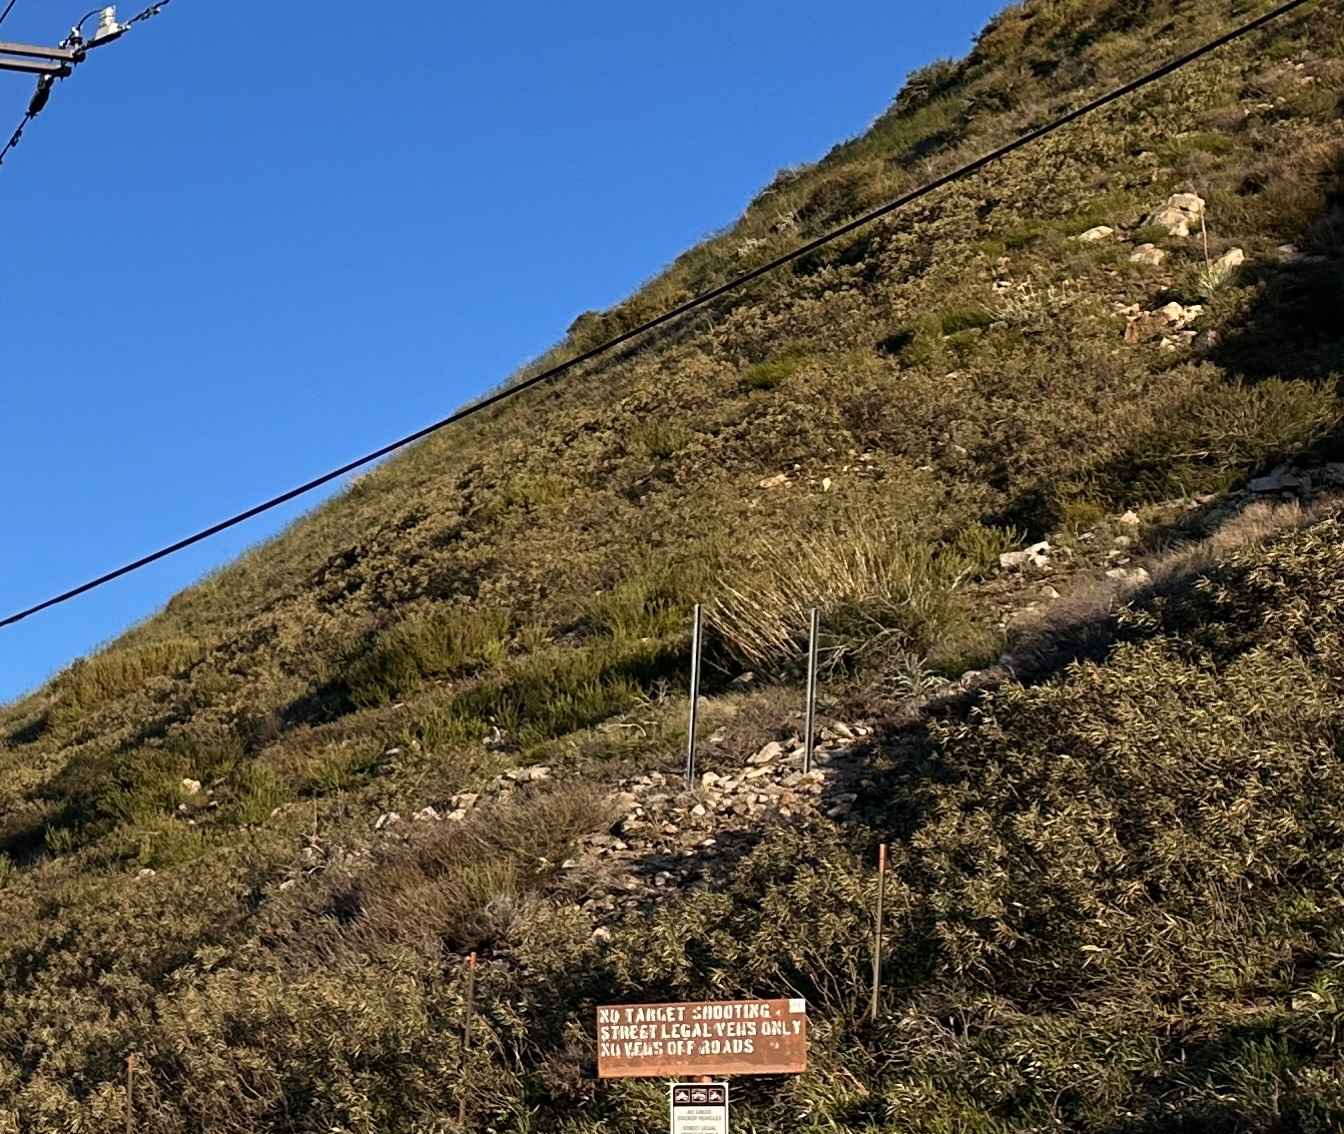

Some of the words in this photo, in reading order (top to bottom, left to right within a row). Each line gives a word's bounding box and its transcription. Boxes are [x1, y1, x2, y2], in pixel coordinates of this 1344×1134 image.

[600, 1008, 621, 1023] NO
[625, 1006, 686, 1023] TARGET
[692, 1003, 770, 1020] SHOOTING
[600, 1024, 657, 1040] STREET
[661, 1022, 712, 1038] LEGAL
[761, 1020, 801, 1036] ONLY
[600, 1041, 621, 1057] NO
[667, 1040, 694, 1056] OFF
[699, 1038, 754, 1055] ROADS
